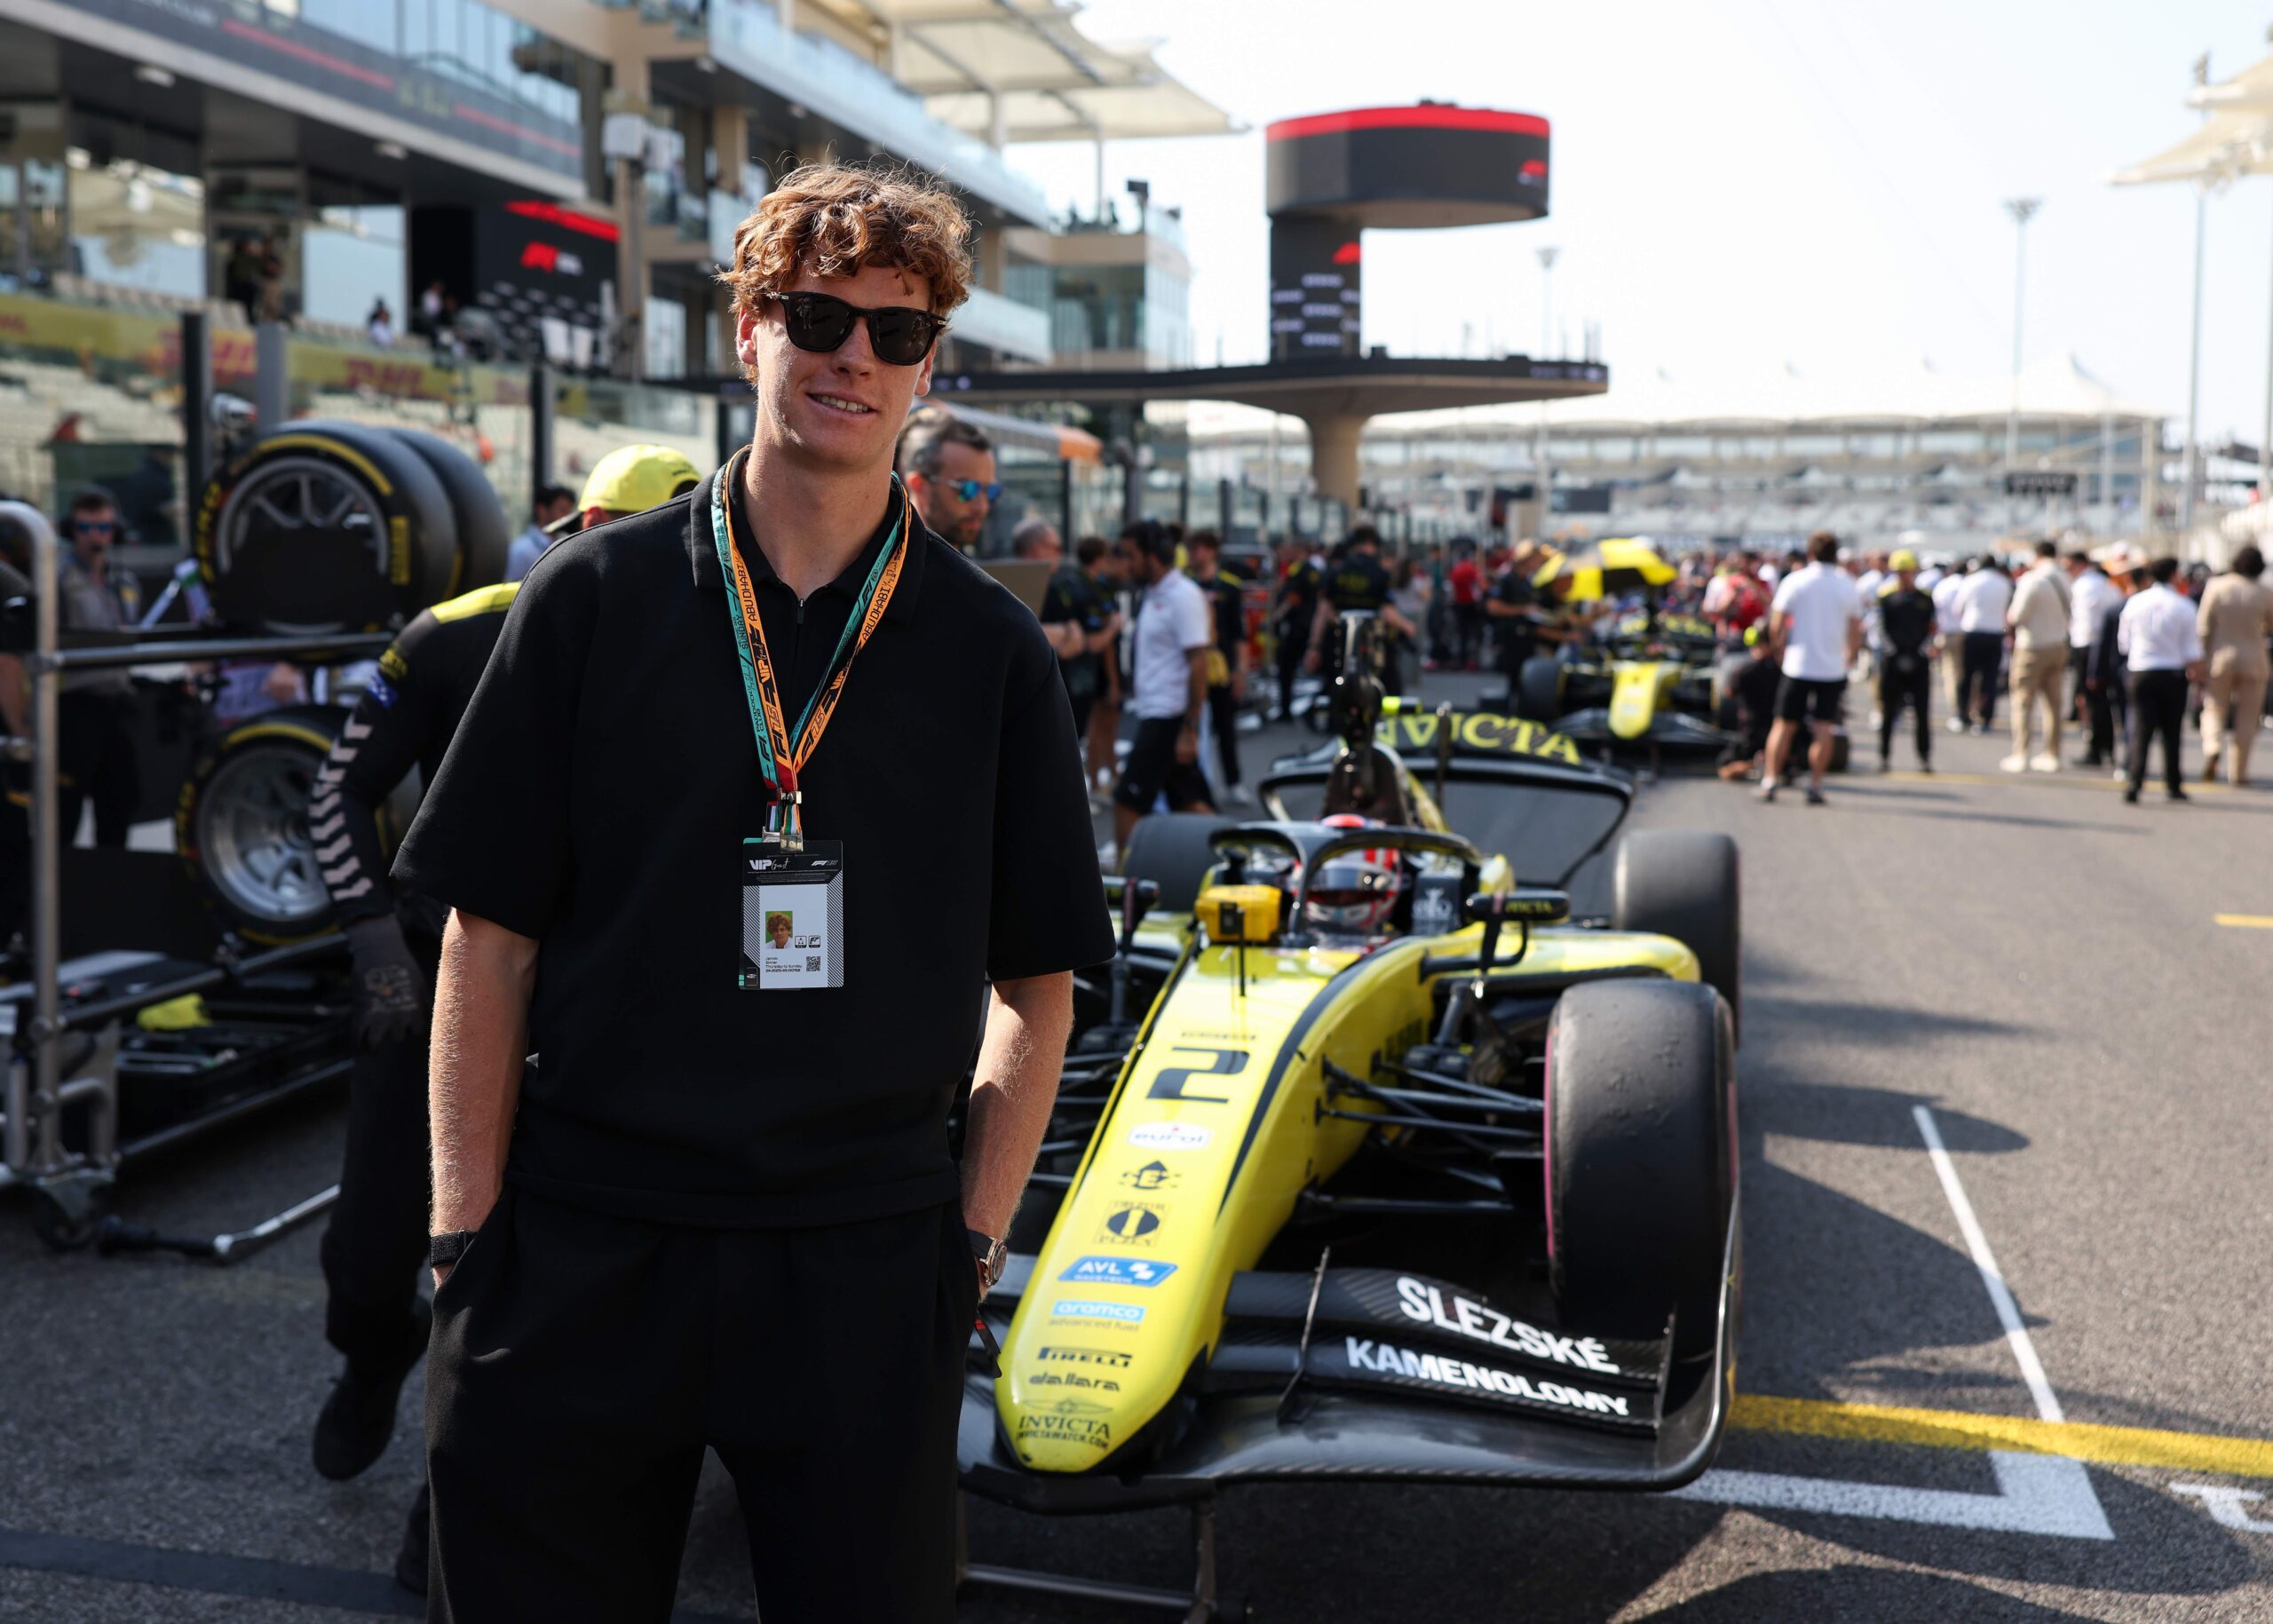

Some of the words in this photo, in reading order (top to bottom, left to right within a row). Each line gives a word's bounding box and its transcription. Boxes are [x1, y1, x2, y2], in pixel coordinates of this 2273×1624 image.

[736, 614, 748, 650] SUNDAY
[757, 660, 771, 683] VIP
[748, 690, 761, 733] PADDOCK
[756, 708, 765, 732] CLUB
[1374, 712, 1582, 766] NVICTA
[748, 860, 772, 871] VIP
[1145, 1046, 1250, 1104] 2
[1077, 1260, 1122, 1275] AVL
[1057, 1302, 1141, 1320] aramco
[1048, 1317, 1112, 1330] advanced
[1113, 1319, 1140, 1333] fuel
[1397, 1276, 1621, 1374] SLEZSKÉ
[1037, 1346, 1133, 1368] PIRELLI
[1028, 1371, 1121, 1392] dallara
[1345, 1336, 1630, 1416] KAMENOLOMY
[1018, 1415, 1111, 1440] INVICTA
